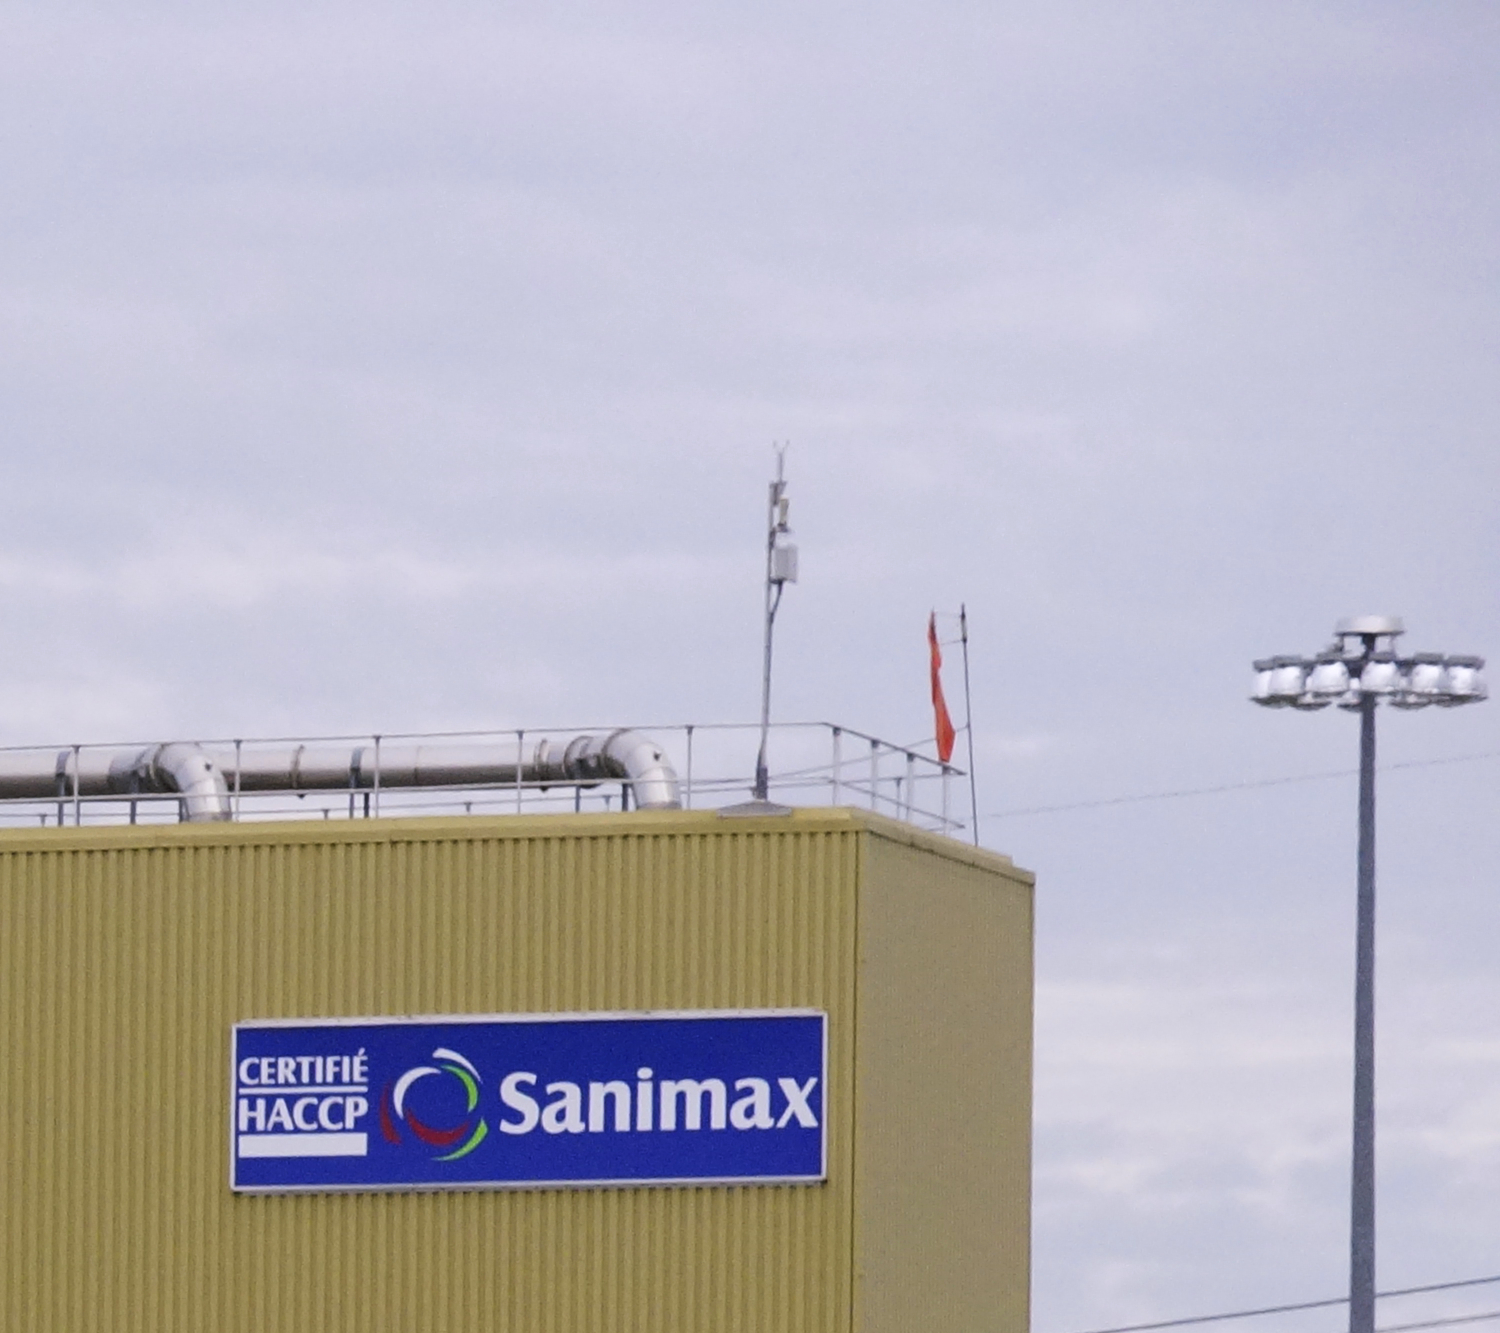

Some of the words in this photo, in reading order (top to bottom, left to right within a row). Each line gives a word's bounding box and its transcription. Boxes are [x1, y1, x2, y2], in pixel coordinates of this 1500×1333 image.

[238, 1047, 369, 1086] CERTIFIÉ
[238, 1096, 368, 1131] HACCP
[499, 1067, 819, 1135] Sanimax
